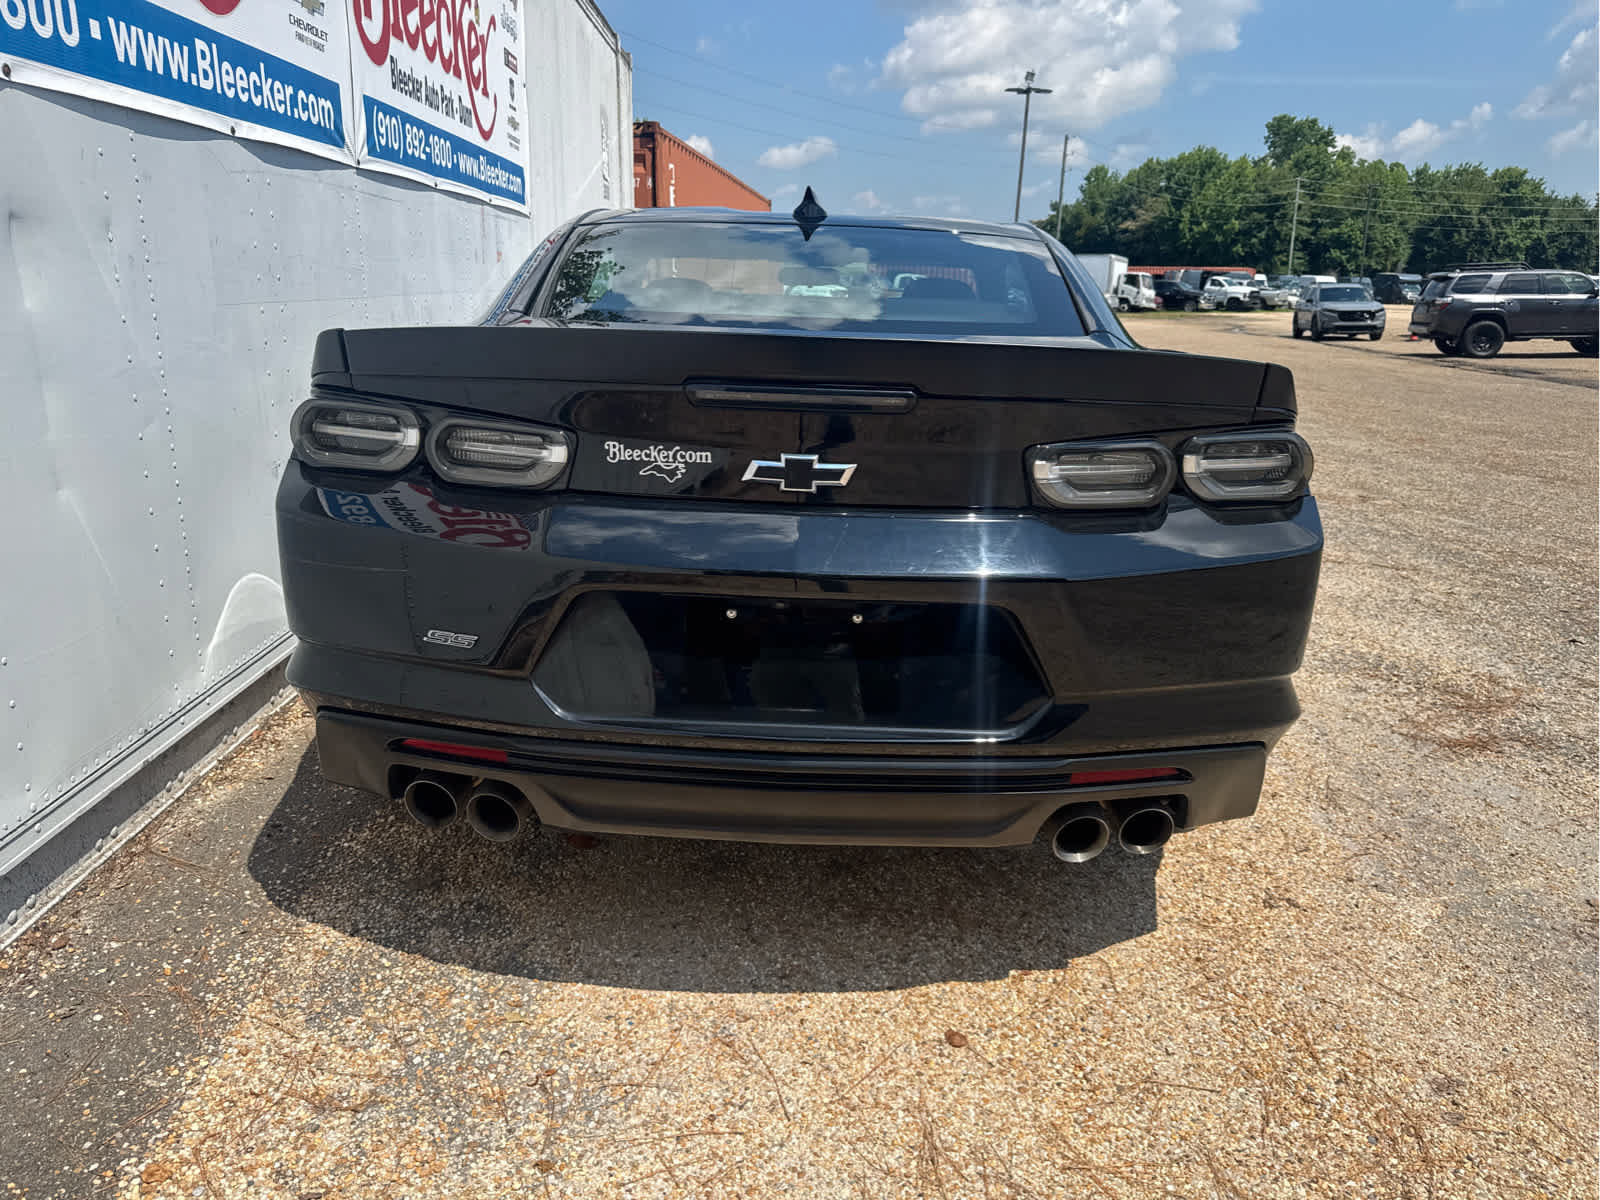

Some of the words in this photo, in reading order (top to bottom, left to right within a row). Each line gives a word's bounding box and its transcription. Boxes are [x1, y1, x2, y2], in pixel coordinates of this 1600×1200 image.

[288, 13, 328, 42] CHEVROLET
[107, 16, 335, 130] www.Bleecker.com
[389, 54, 423, 104] Bleecker
[424, 75, 440, 113] Auto
[440, 84, 456, 120] Park
[373, 105, 404, 159] (910)
[405, 123, 453, 169] 892-1800
[457, 151, 523, 197] www.Bleecker.com
[423, 629, 479, 649] SS
